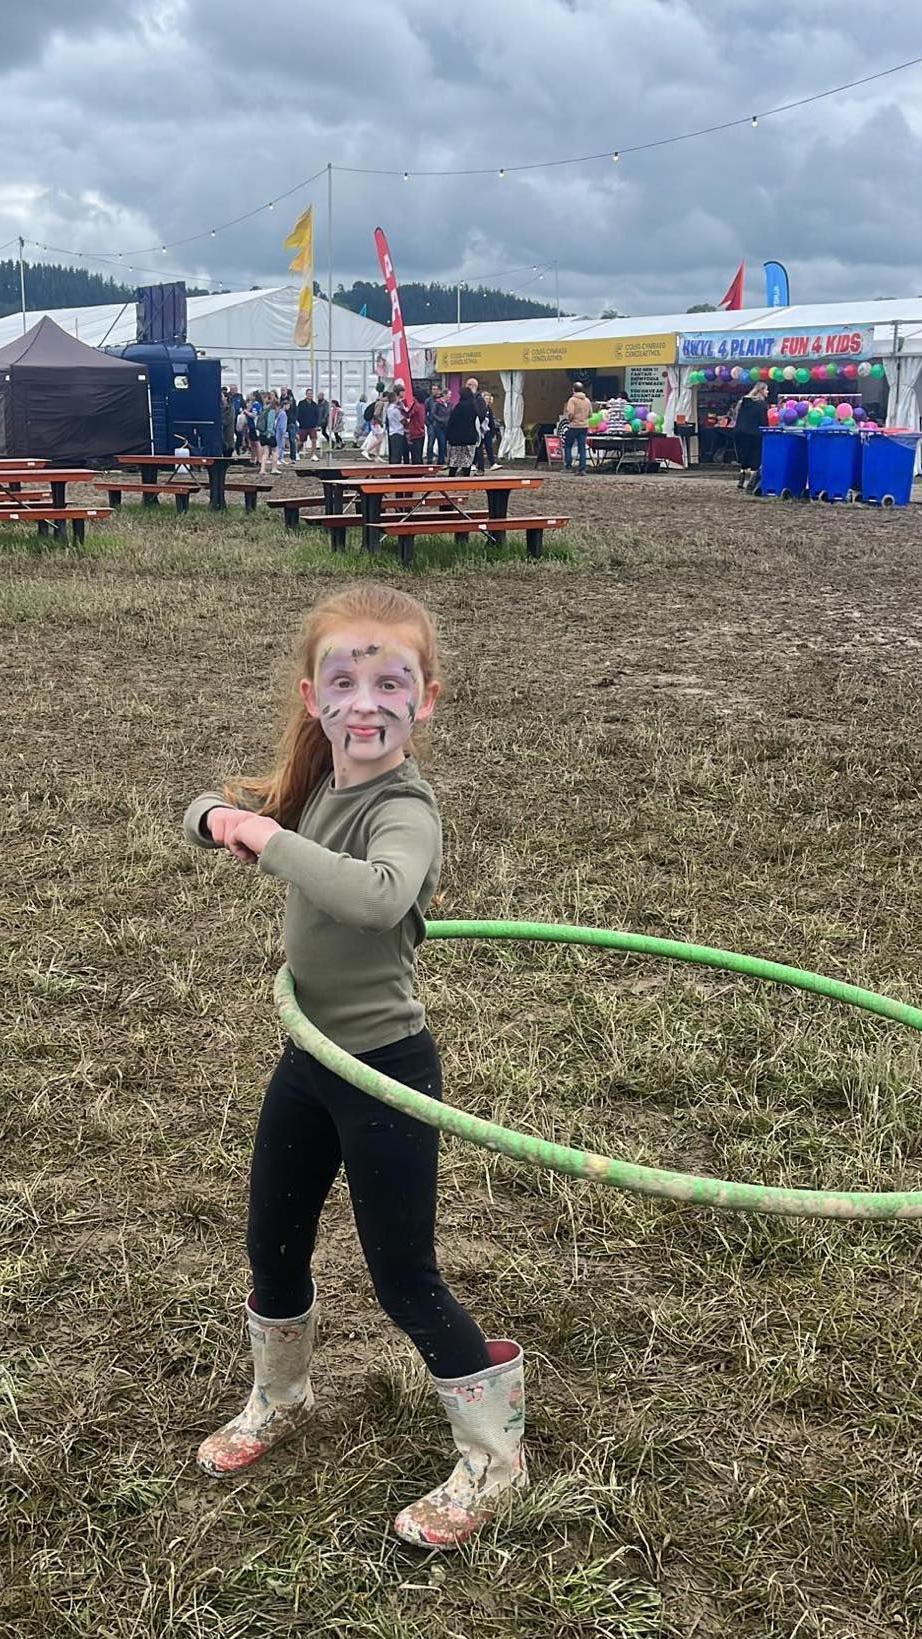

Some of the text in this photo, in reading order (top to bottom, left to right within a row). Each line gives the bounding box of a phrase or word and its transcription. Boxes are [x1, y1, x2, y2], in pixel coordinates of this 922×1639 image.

[682, 333, 862, 357] HWYL 4 PLANT FUN 4 KIDS
